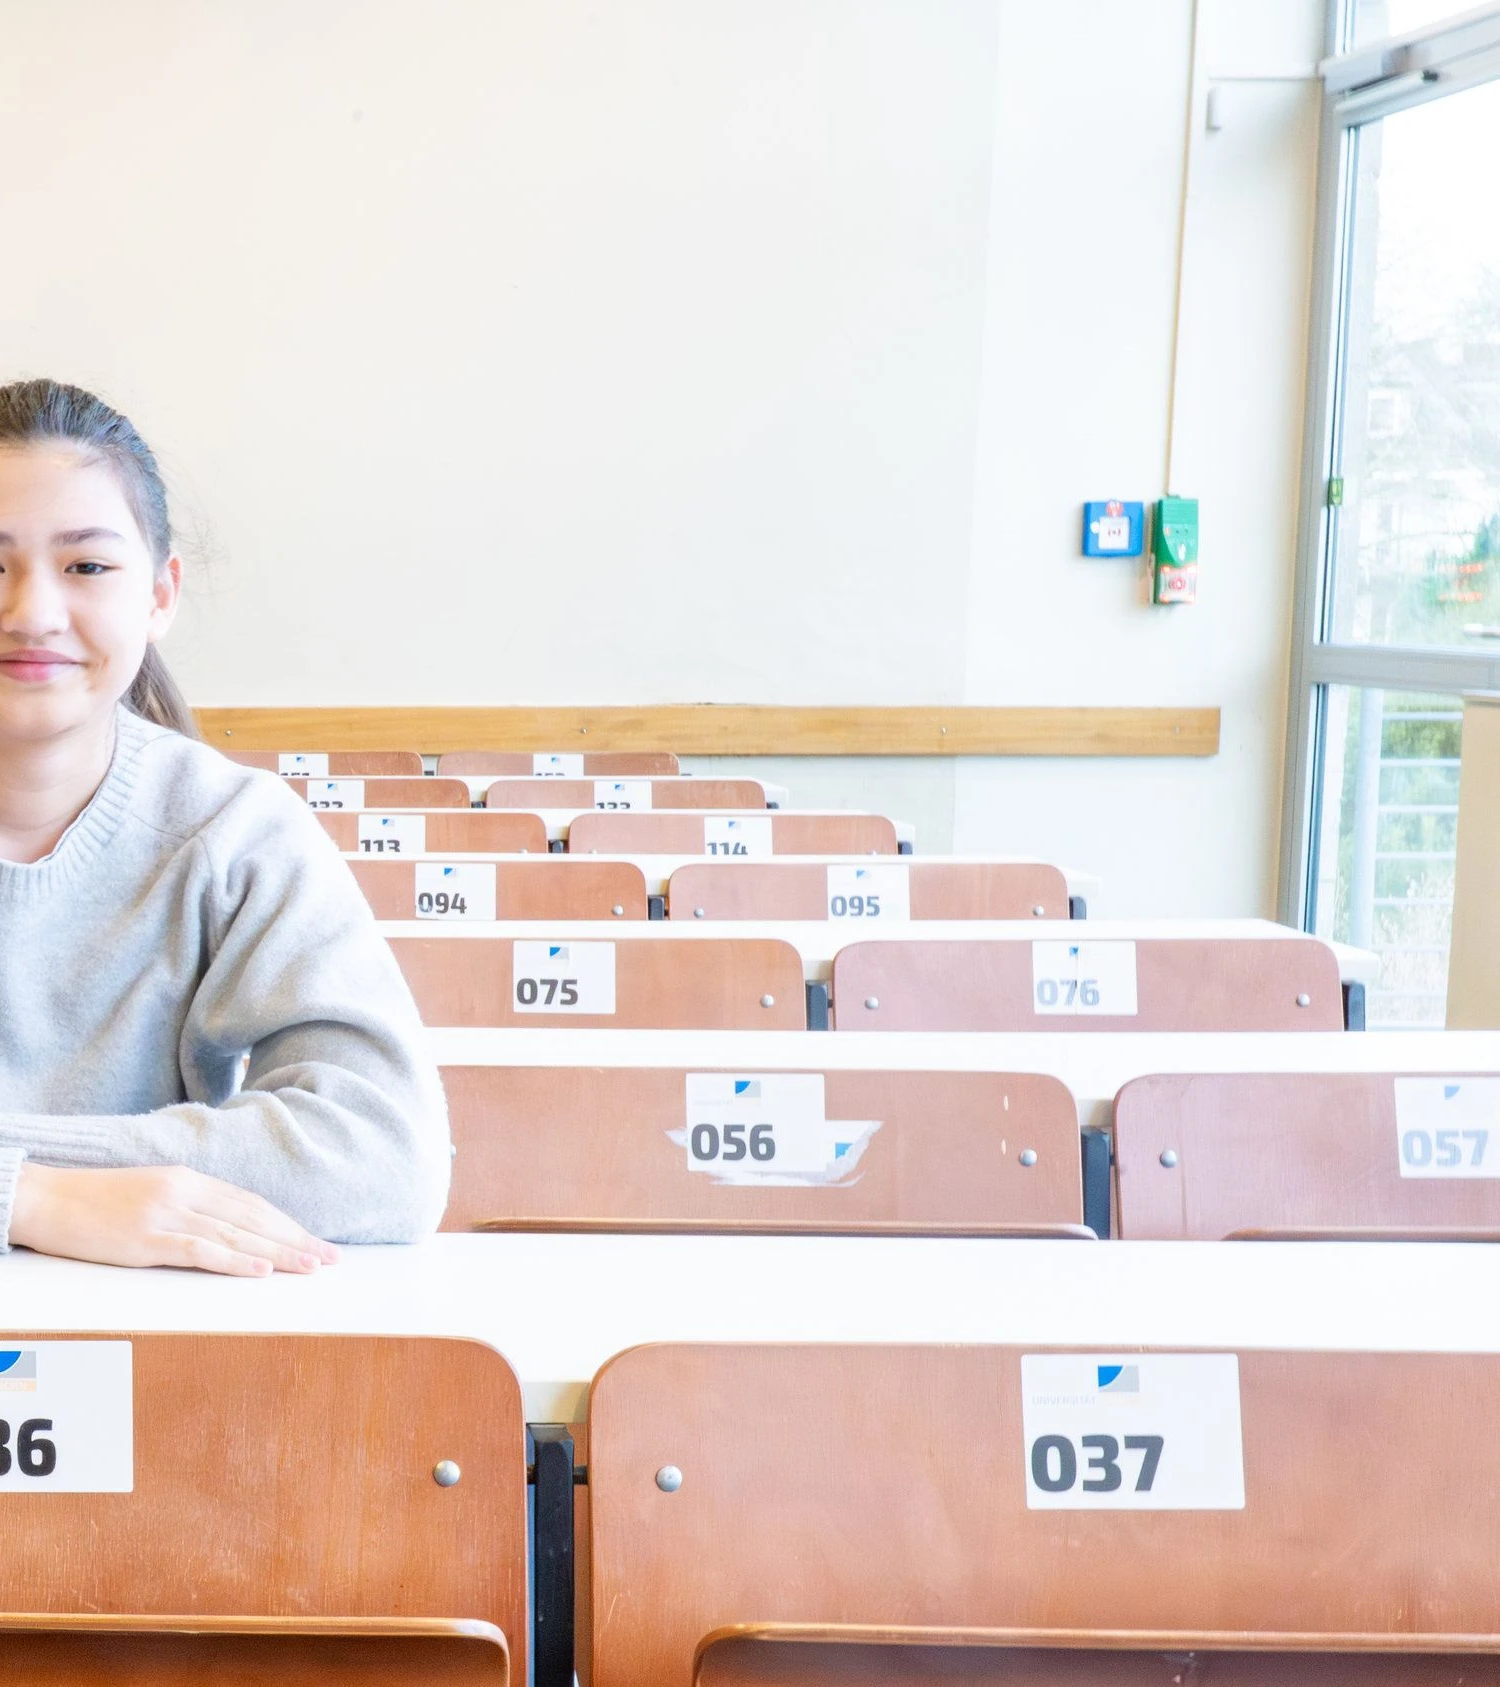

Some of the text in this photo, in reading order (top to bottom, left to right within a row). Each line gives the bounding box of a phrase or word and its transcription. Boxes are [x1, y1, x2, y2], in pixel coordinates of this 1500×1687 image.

[360, 839, 401, 852] 113
[707, 842, 748, 855] 114
[418, 892, 467, 914] 094
[830, 895, 881, 917] 095
[516, 978, 579, 1006] 075
[1037, 978, 1100, 1007] 076
[690, 1123, 776, 1162] 056
[1402, 1129, 1489, 1167] 057
[1031, 1434, 1164, 1493] 037
